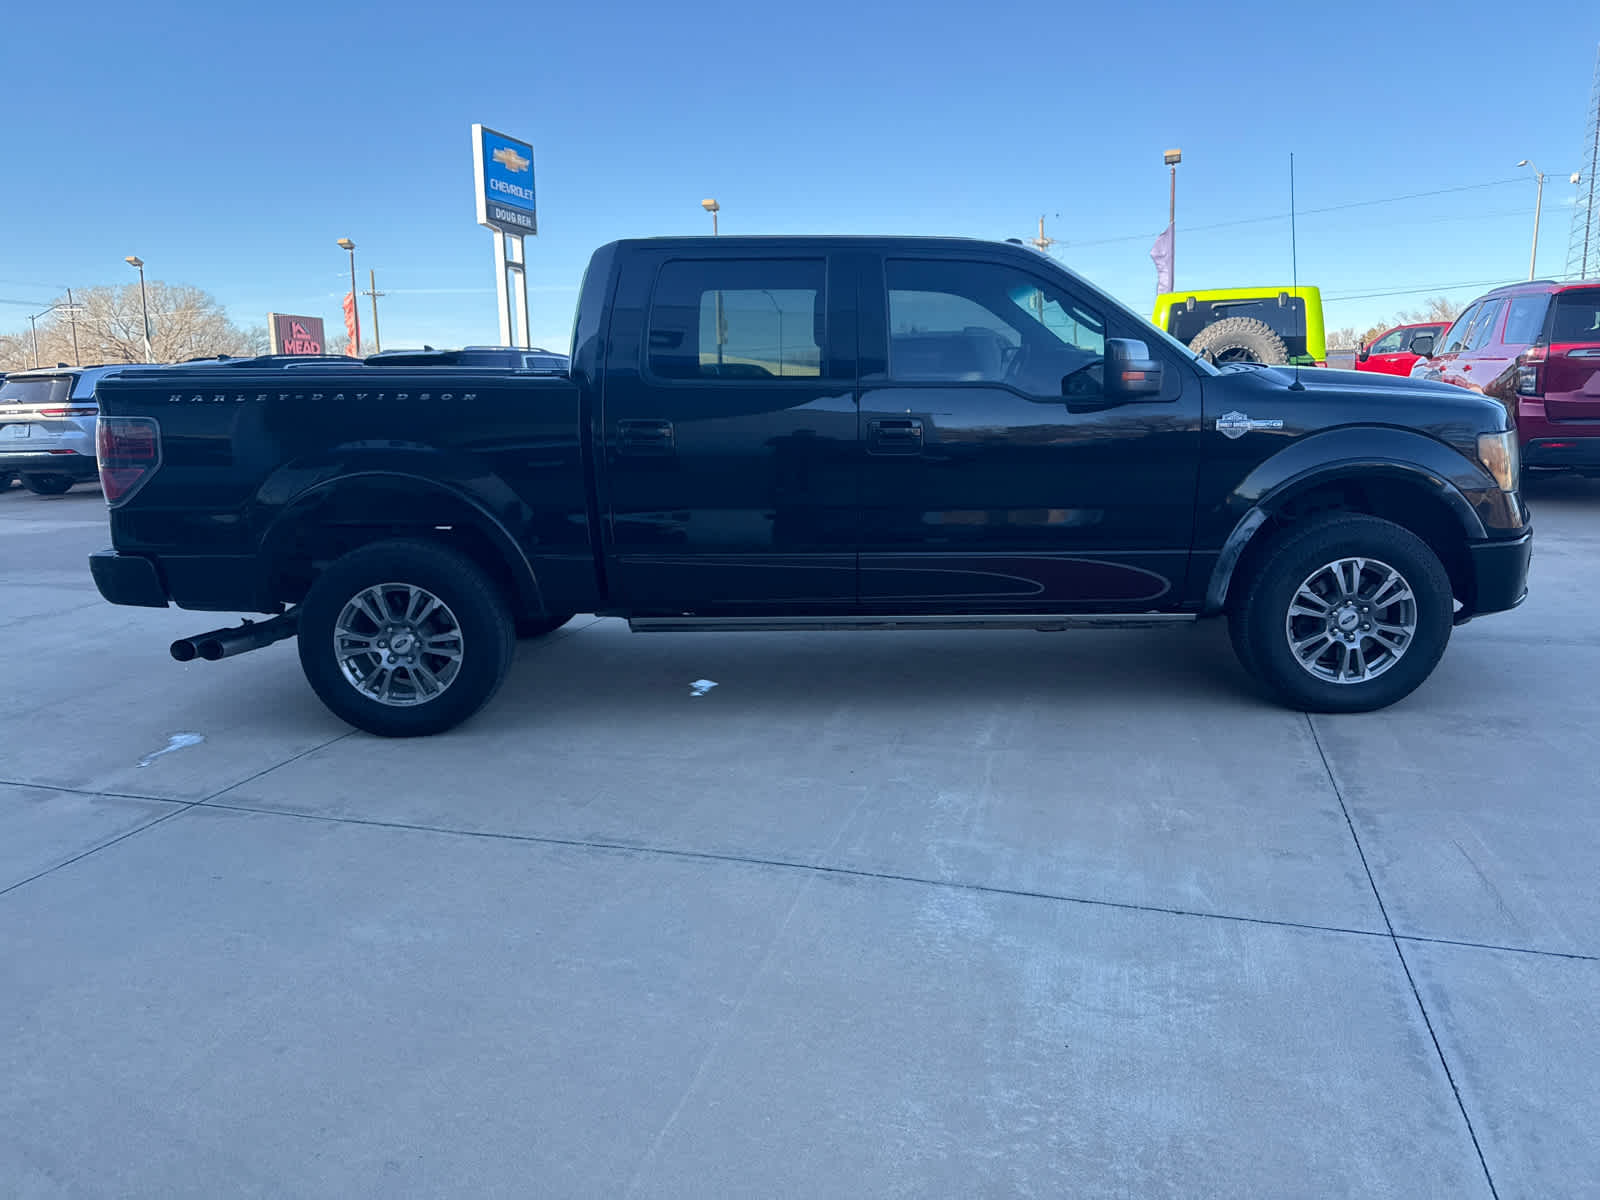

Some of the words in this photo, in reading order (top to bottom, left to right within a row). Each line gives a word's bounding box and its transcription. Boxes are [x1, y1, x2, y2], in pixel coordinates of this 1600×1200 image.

[490, 179, 533, 200] CHEVROLET
[495, 208, 516, 223] DOUG
[284, 339, 321, 354] MEAD
[168, 393, 477, 402] HARLEY-DAVIDSON
